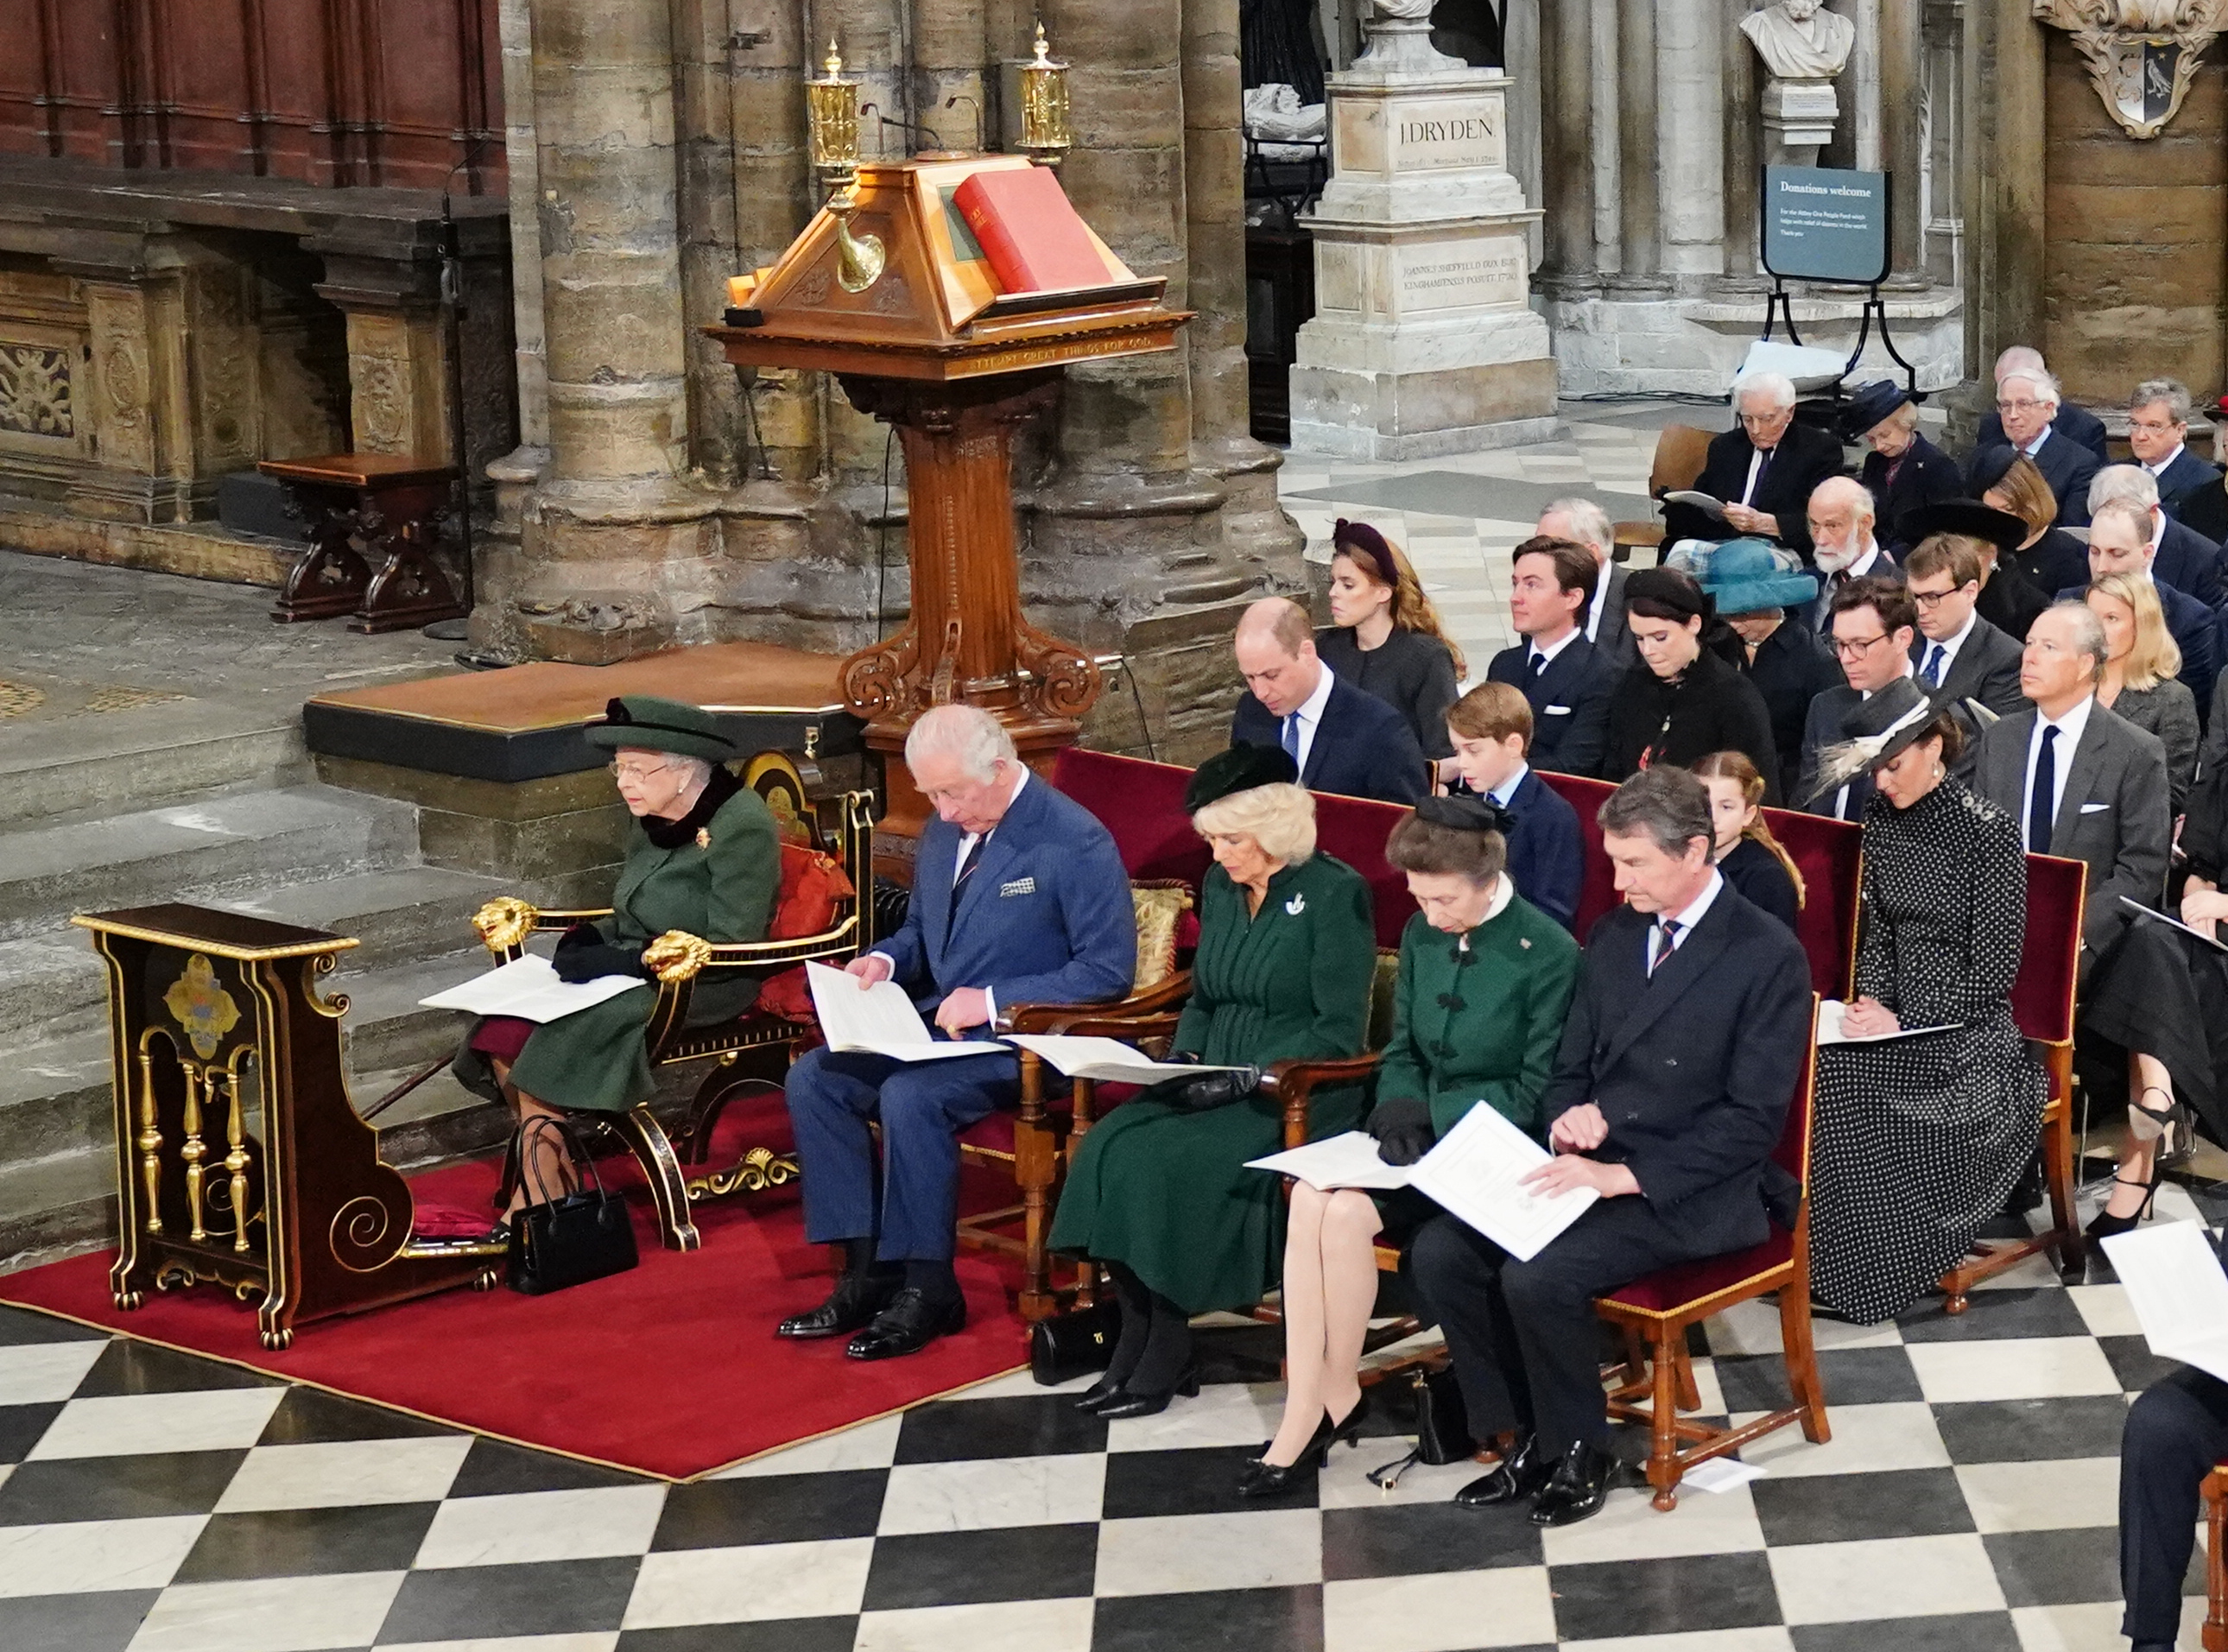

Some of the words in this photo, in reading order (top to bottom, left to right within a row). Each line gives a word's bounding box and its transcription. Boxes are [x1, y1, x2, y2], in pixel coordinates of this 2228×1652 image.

[1781, 181, 1828, 194] Donations
[1830, 186, 1871, 197] welcome
[1023, 351, 1056, 363] GREAT
[1063, 345, 1099, 357] THINGS
[1105, 340, 1124, 351] FOR
